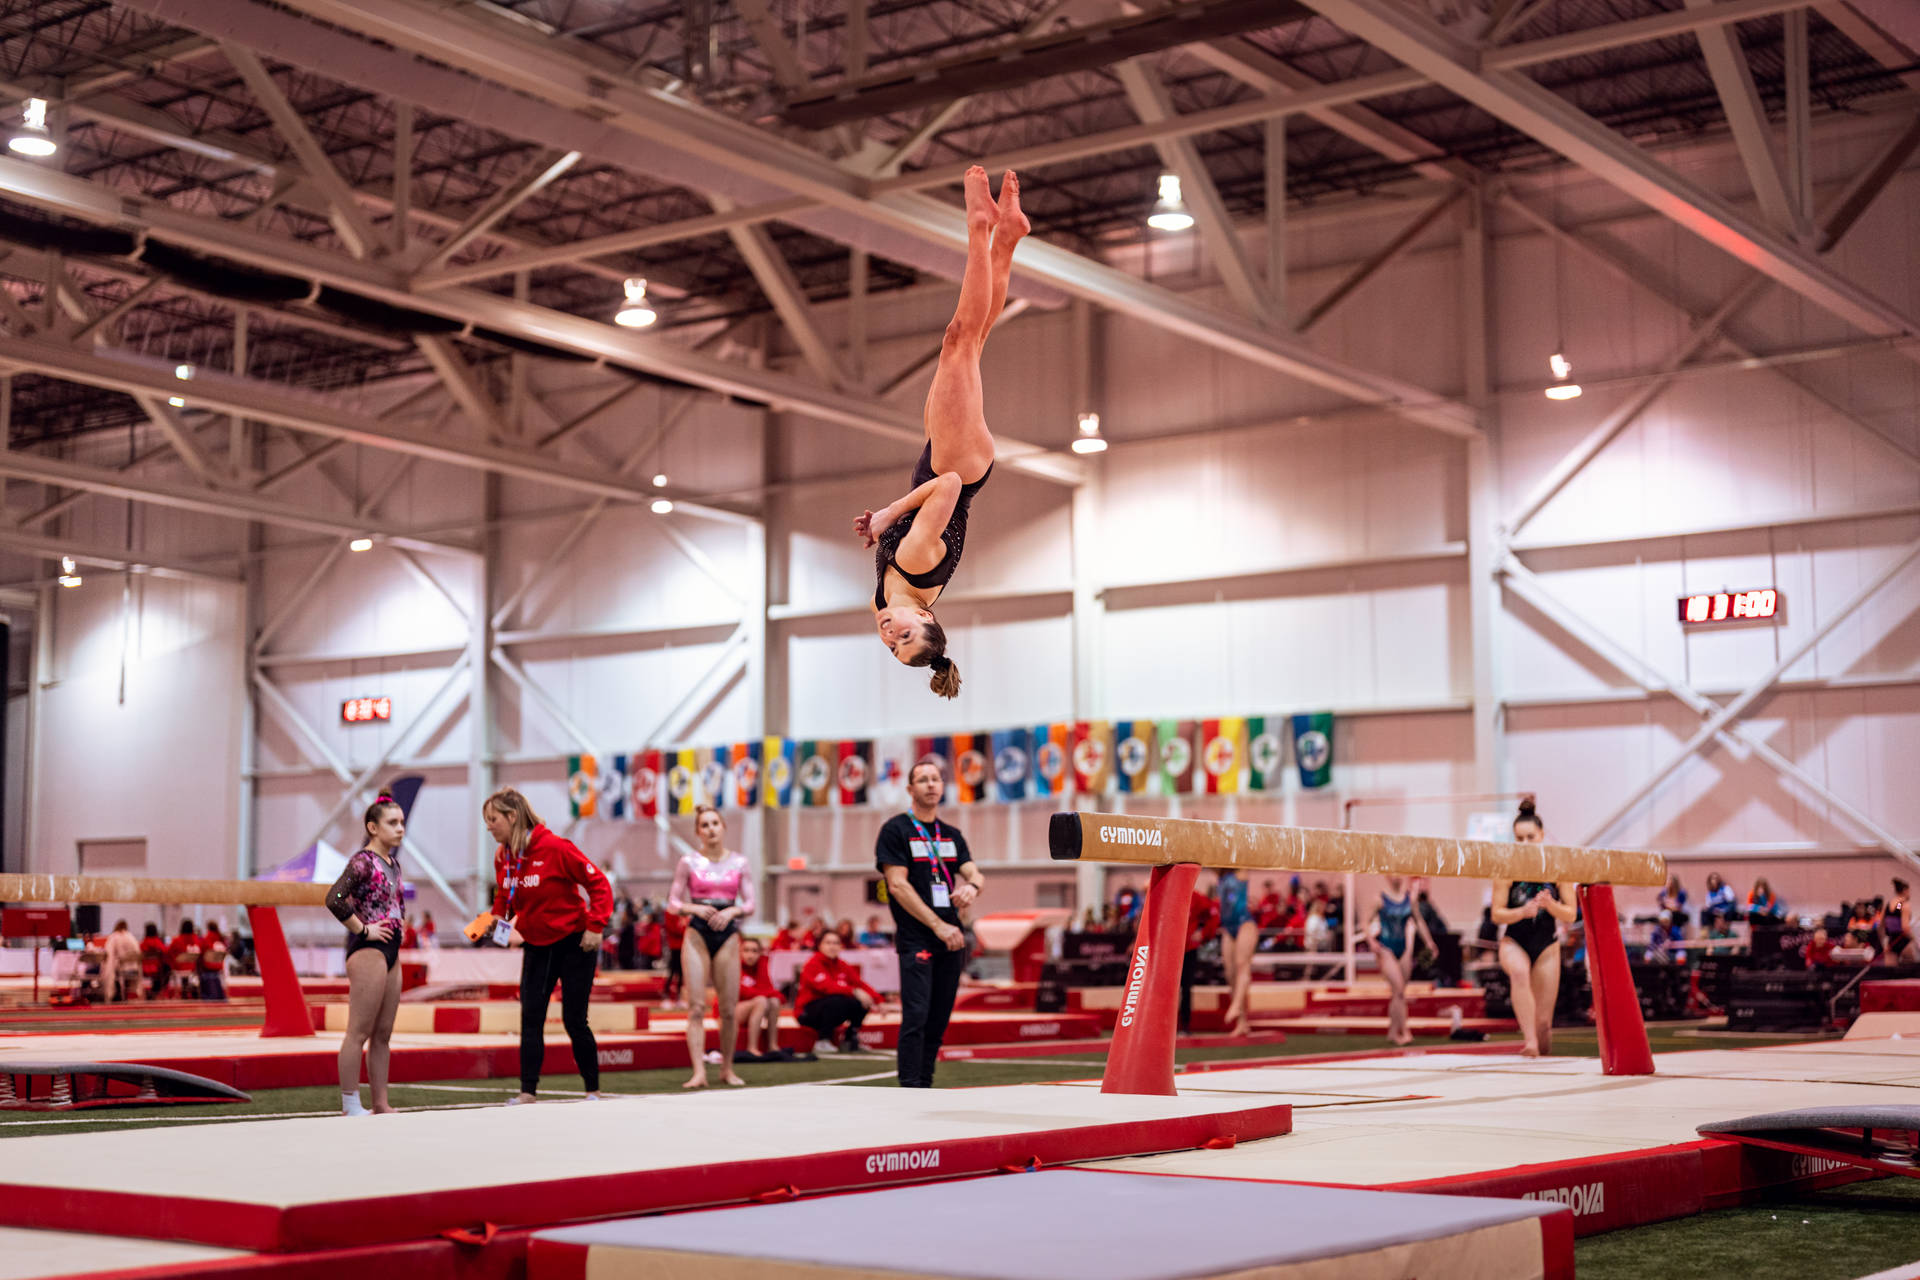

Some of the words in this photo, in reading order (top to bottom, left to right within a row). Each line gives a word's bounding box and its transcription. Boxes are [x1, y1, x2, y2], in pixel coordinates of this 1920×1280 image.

[1100, 825, 1162, 847] GYMNOVA
[1121, 945, 1149, 1027] GYMNOVA
[866, 1149, 940, 1173] GYMNOVA
